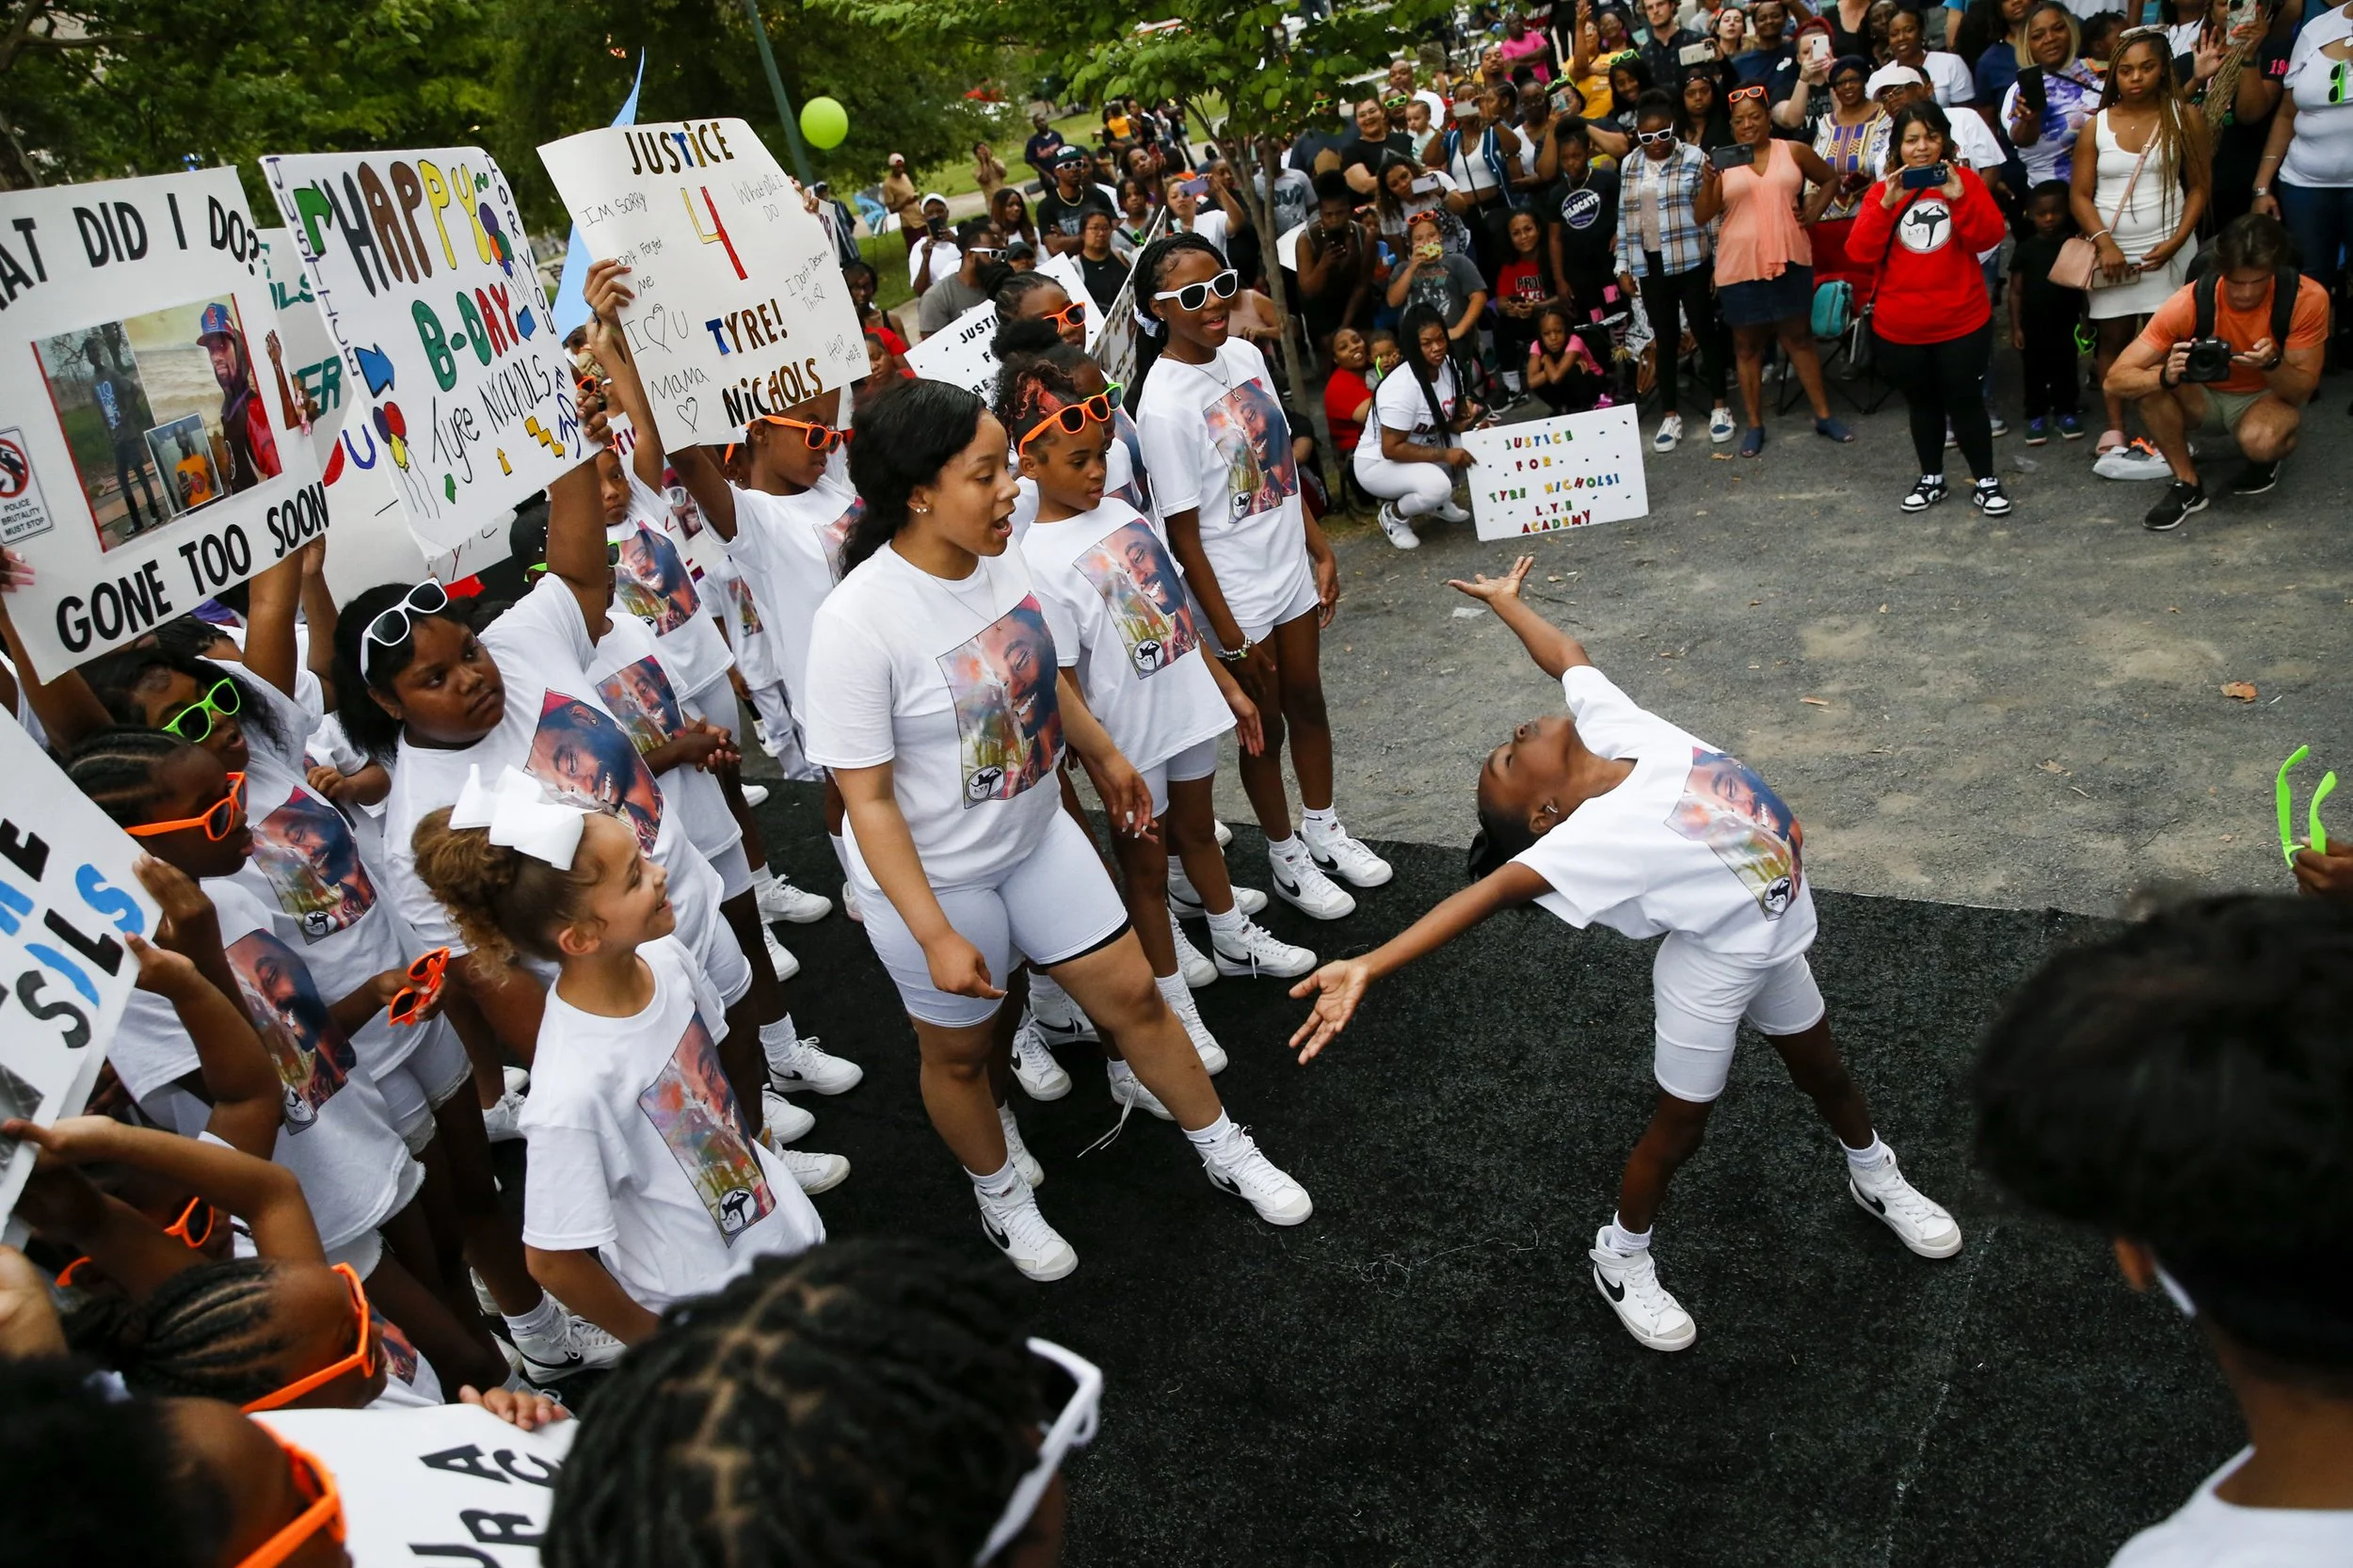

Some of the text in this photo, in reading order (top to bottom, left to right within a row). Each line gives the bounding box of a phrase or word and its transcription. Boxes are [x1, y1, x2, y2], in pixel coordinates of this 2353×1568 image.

[72, 201, 149, 268] DID
[167, 193, 188, 250] I
[208, 195, 261, 276] DO?
[323, 158, 492, 298] HAPPY
[680, 185, 749, 281] 4
[1907, 227, 1929, 236] LYE
[484, 153, 557, 336] FOR YOU
[784, 278, 797, 297] I
[410, 281, 519, 392] B-DAY
[623, 311, 689, 355] I U
[704, 297, 789, 356] TYRE!
[959, 314, 999, 344] JUSTI
[476, 353, 552, 435] NICHOLS
[1504, 429, 1574, 451] JUSTICE
[1515, 456, 1553, 472] FOR
[4, 498, 31, 512] POLICE
[1488, 487, 1527, 504] TYRE
[1, 506, 40, 526] BRUTALITY
[5, 517, 45, 536] MUST STOP
[1521, 509, 1592, 534] ACADEMY
[56, 481, 329, 653] GONE TOO SOON
